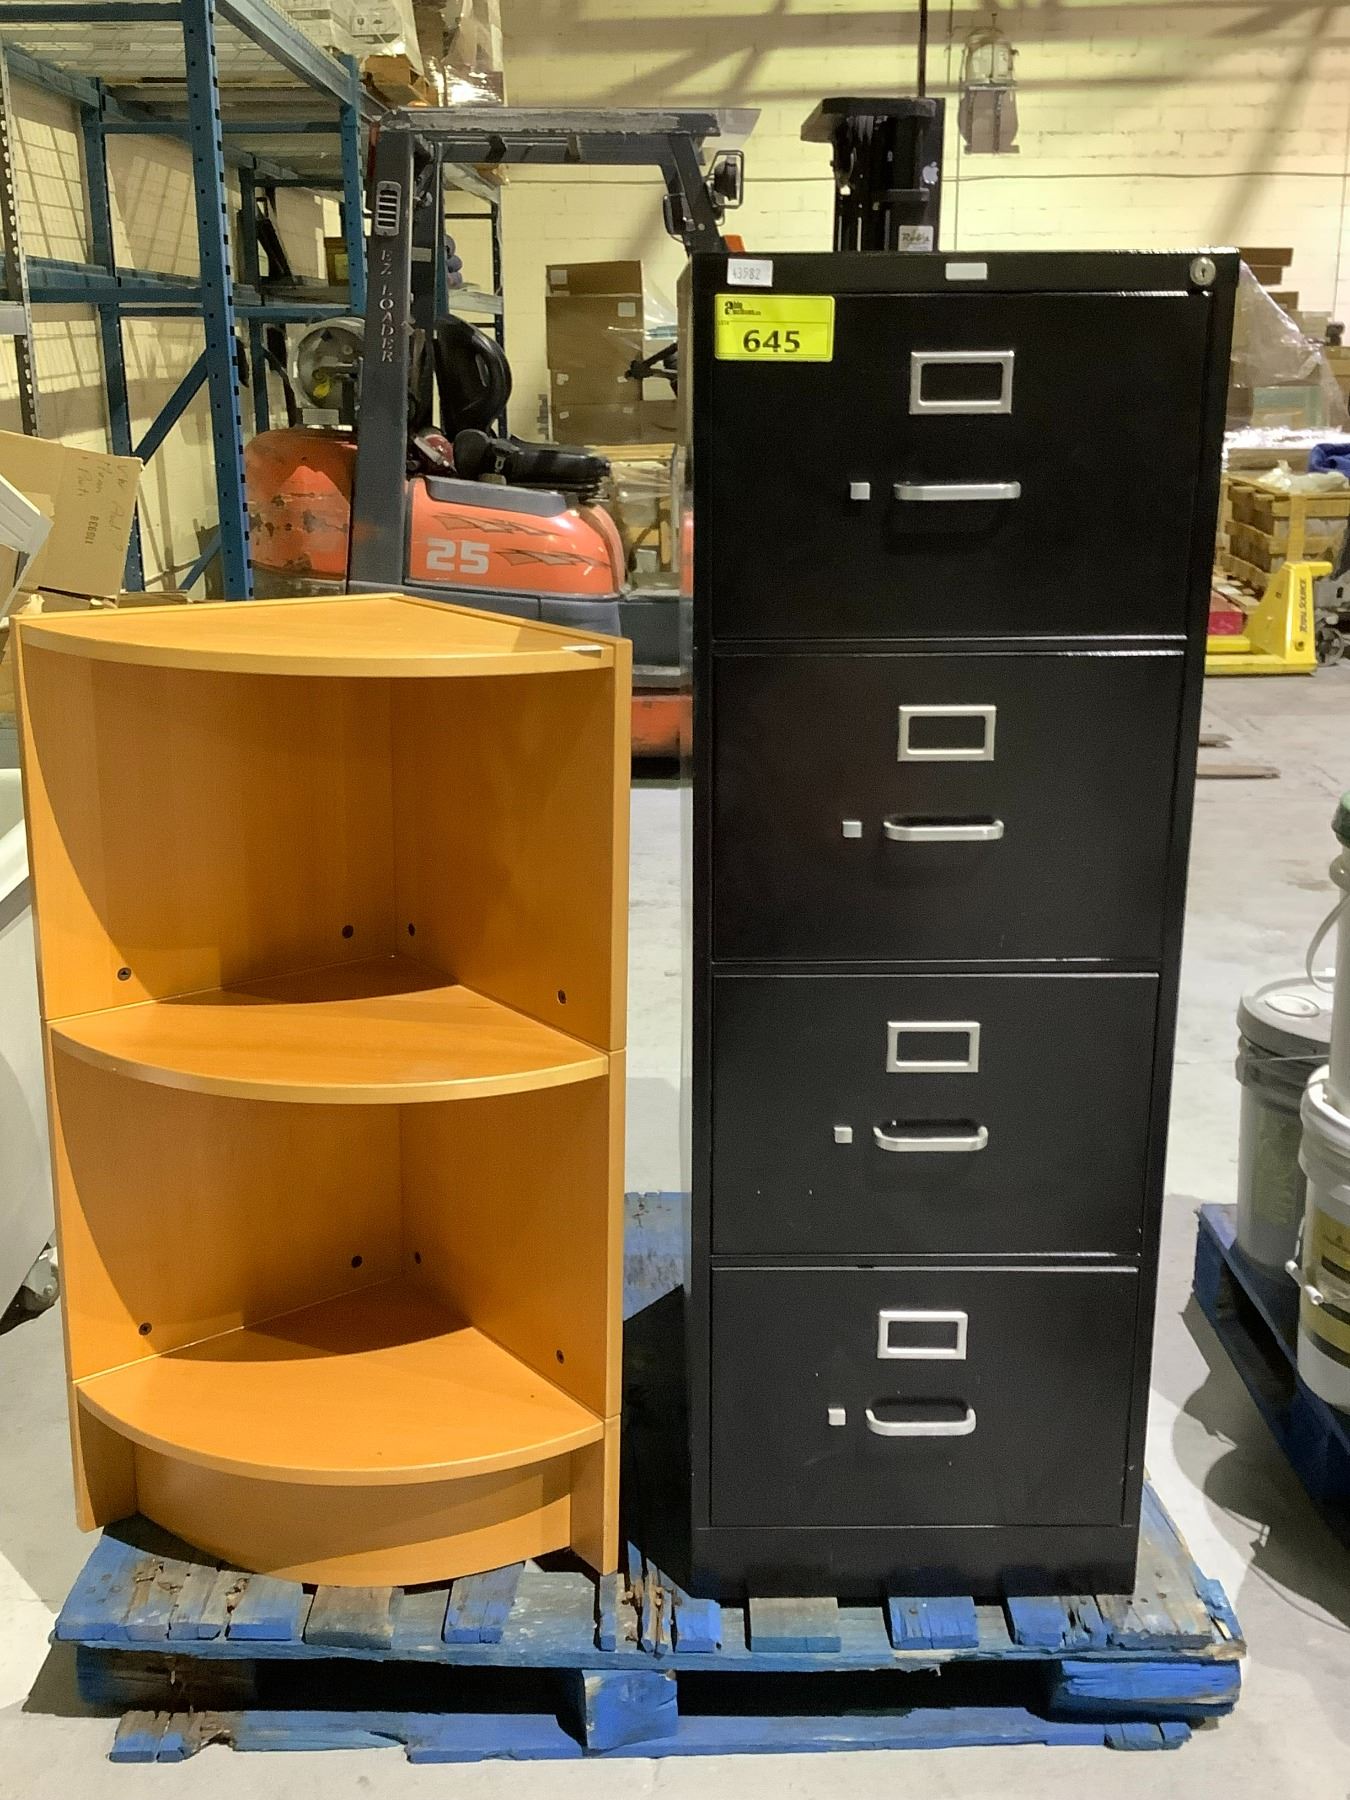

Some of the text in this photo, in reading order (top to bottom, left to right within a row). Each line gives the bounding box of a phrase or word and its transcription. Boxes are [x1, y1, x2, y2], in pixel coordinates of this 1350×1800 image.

[732, 267, 761, 281] 43582
[379, 249, 395, 363] EZ LOADER
[743, 329, 801, 353] 645
[426, 537, 490, 575] 25
